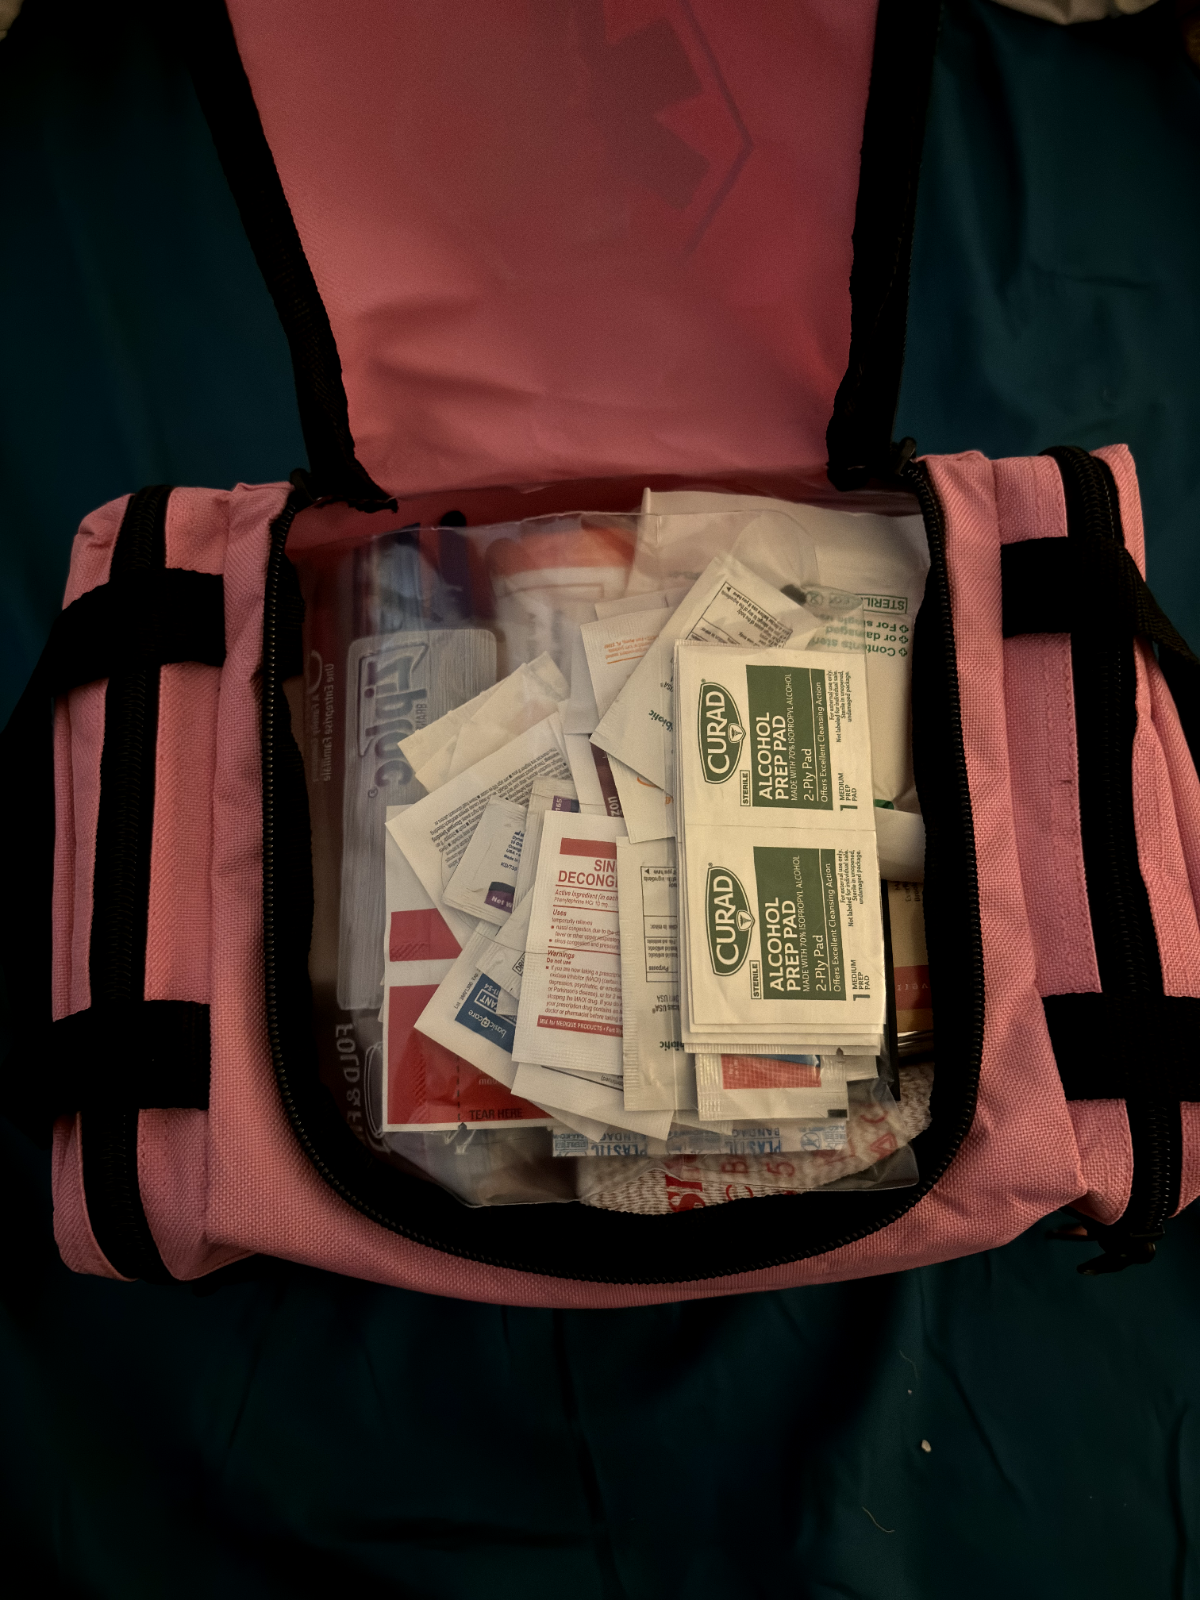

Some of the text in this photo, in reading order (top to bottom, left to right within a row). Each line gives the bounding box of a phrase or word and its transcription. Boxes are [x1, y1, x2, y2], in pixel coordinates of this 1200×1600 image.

[859, 596, 904, 610] STERIL
[875, 622, 896, 631] For
[883, 634, 896, 642] or
[785, 673, 793, 705] ALCOHOL
[706, 690, 730, 774] CURAD
[787, 706, 796, 743] ISOPROPYL
[815, 682, 828, 802] Offers Excellent Cleansing Action
[756, 712, 773, 800] ALCOHOL
[772, 715, 789, 800] PREP PAD
[789, 760, 797, 778] WITH
[801, 748, 816, 801] 2-Ply Pad
[593, 858, 615, 873] SIN
[552, 908, 566, 916] Uses
[713, 875, 740, 966] CURAD
[793, 855, 810, 992] MADE WITH 70% ISOPROPYL ALCOHOL
[825, 863, 841, 992] Offers Excellent Cleansing Action
[546, 949, 574, 960] Warnings
[764, 897, 784, 992] ALCOHOL
[781, 900, 801, 991] PREP PAD
[812, 934, 829, 992] 2-Ply Pad
[480, 994, 497, 1010] ANT
[468, 1009, 507, 1038] basic care
[469, 1107, 523, 1120] TEAR HERE
